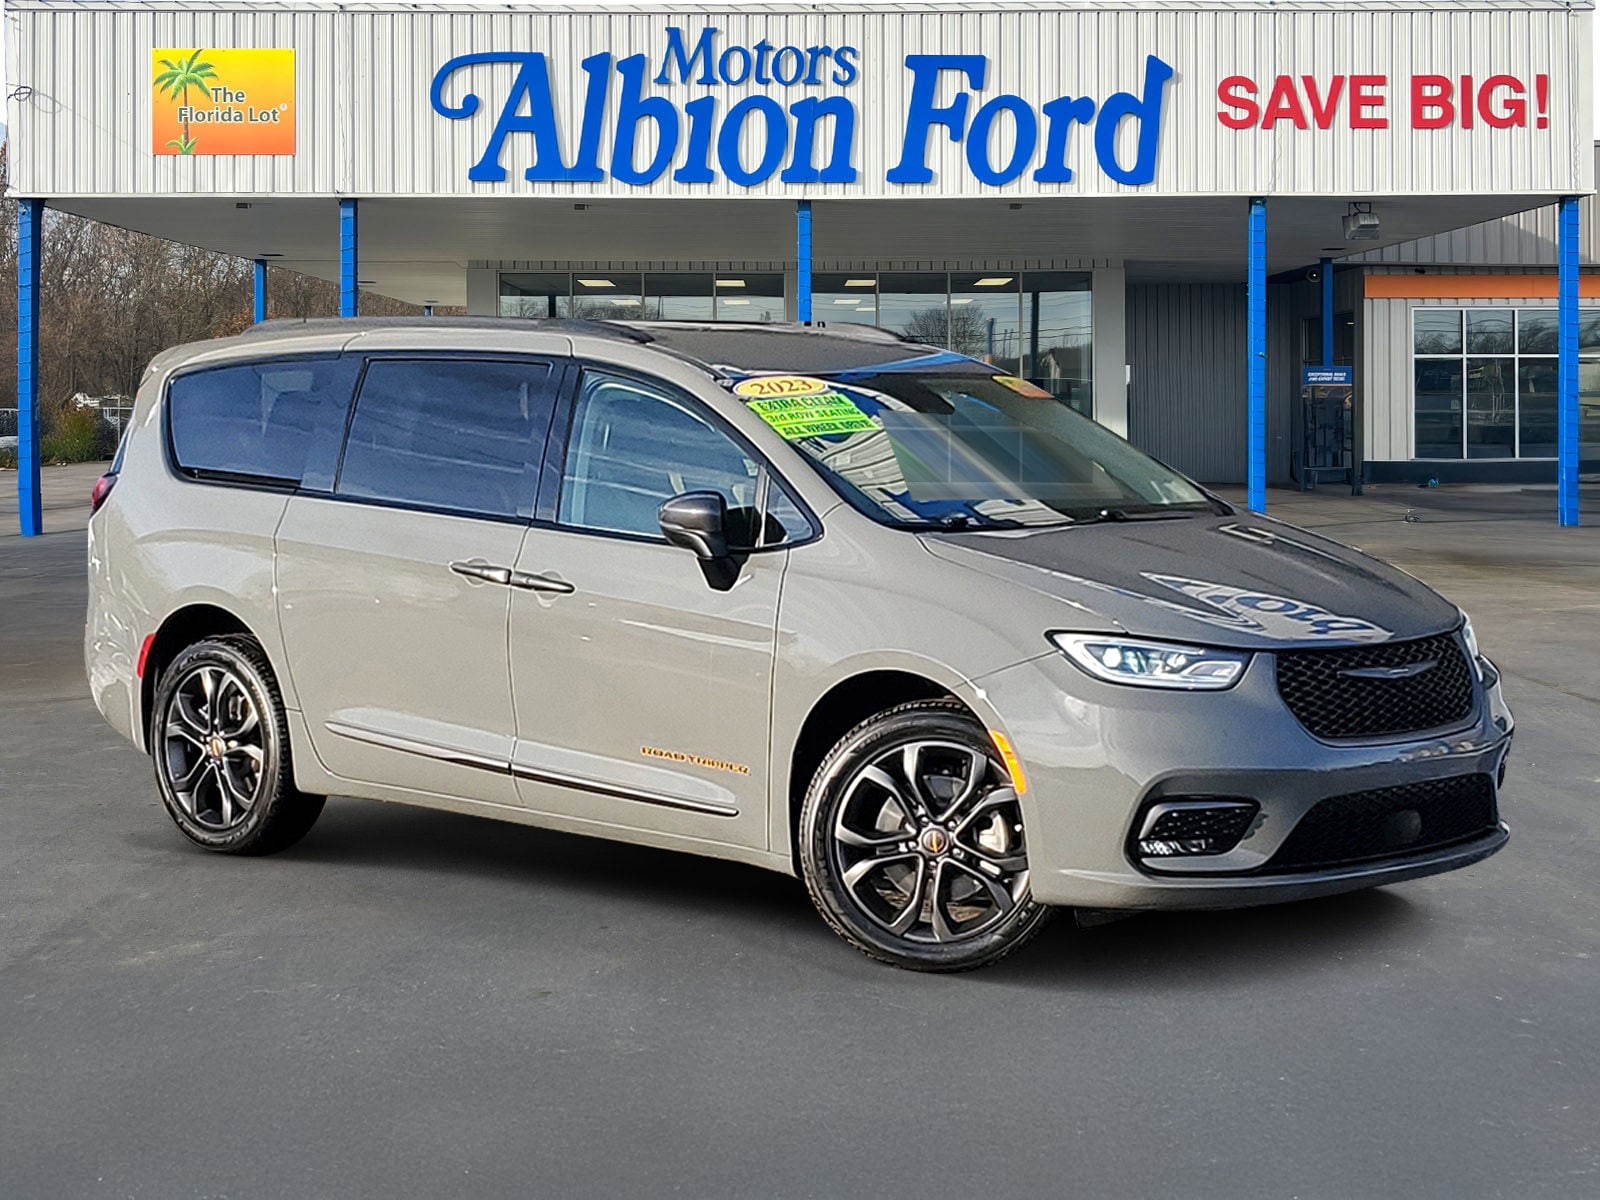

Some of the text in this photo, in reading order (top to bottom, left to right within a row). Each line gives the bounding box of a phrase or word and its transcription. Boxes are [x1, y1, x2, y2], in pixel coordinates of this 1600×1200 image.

[656, 26, 857, 86] Motors
[211, 87, 245, 103] The
[1217, 74, 1549, 130] SAVE BIG!
[178, 107, 243, 122] Florida
[430, 52, 1174, 186] Albion Ford
[750, 379, 813, 395] 2023
[757, 395, 845, 412] EXTRA CLEAN
[815, 407, 861, 419] SEATING
